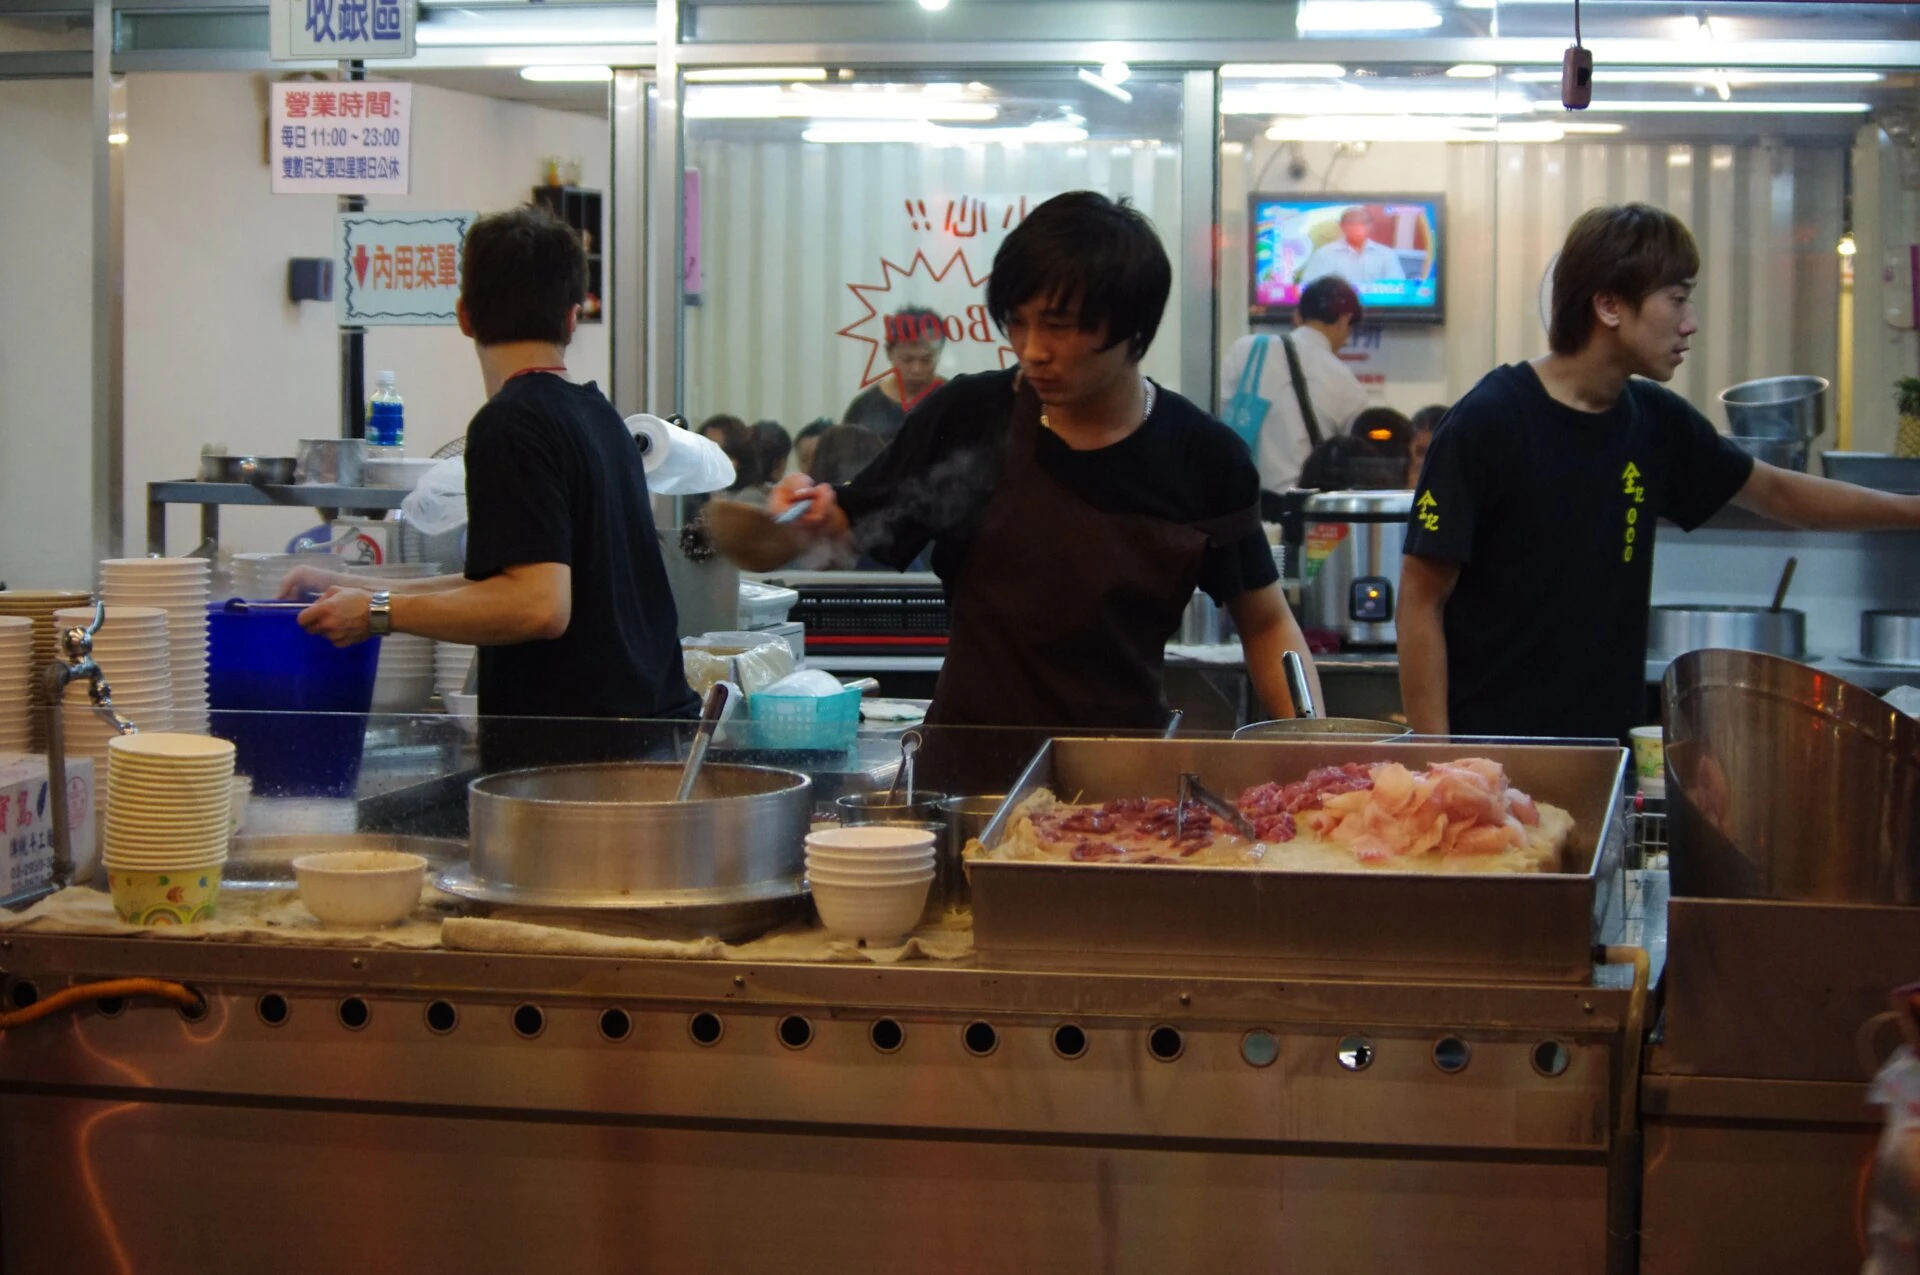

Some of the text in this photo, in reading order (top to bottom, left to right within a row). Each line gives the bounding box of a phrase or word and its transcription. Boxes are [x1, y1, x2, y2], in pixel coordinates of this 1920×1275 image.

[306, 0, 401, 42] 收銀區
[285, 91, 400, 119] 營業時間:
[281, 126, 306, 148] 每日
[282, 156, 400, 179] 雙數月之第四星期日公休
